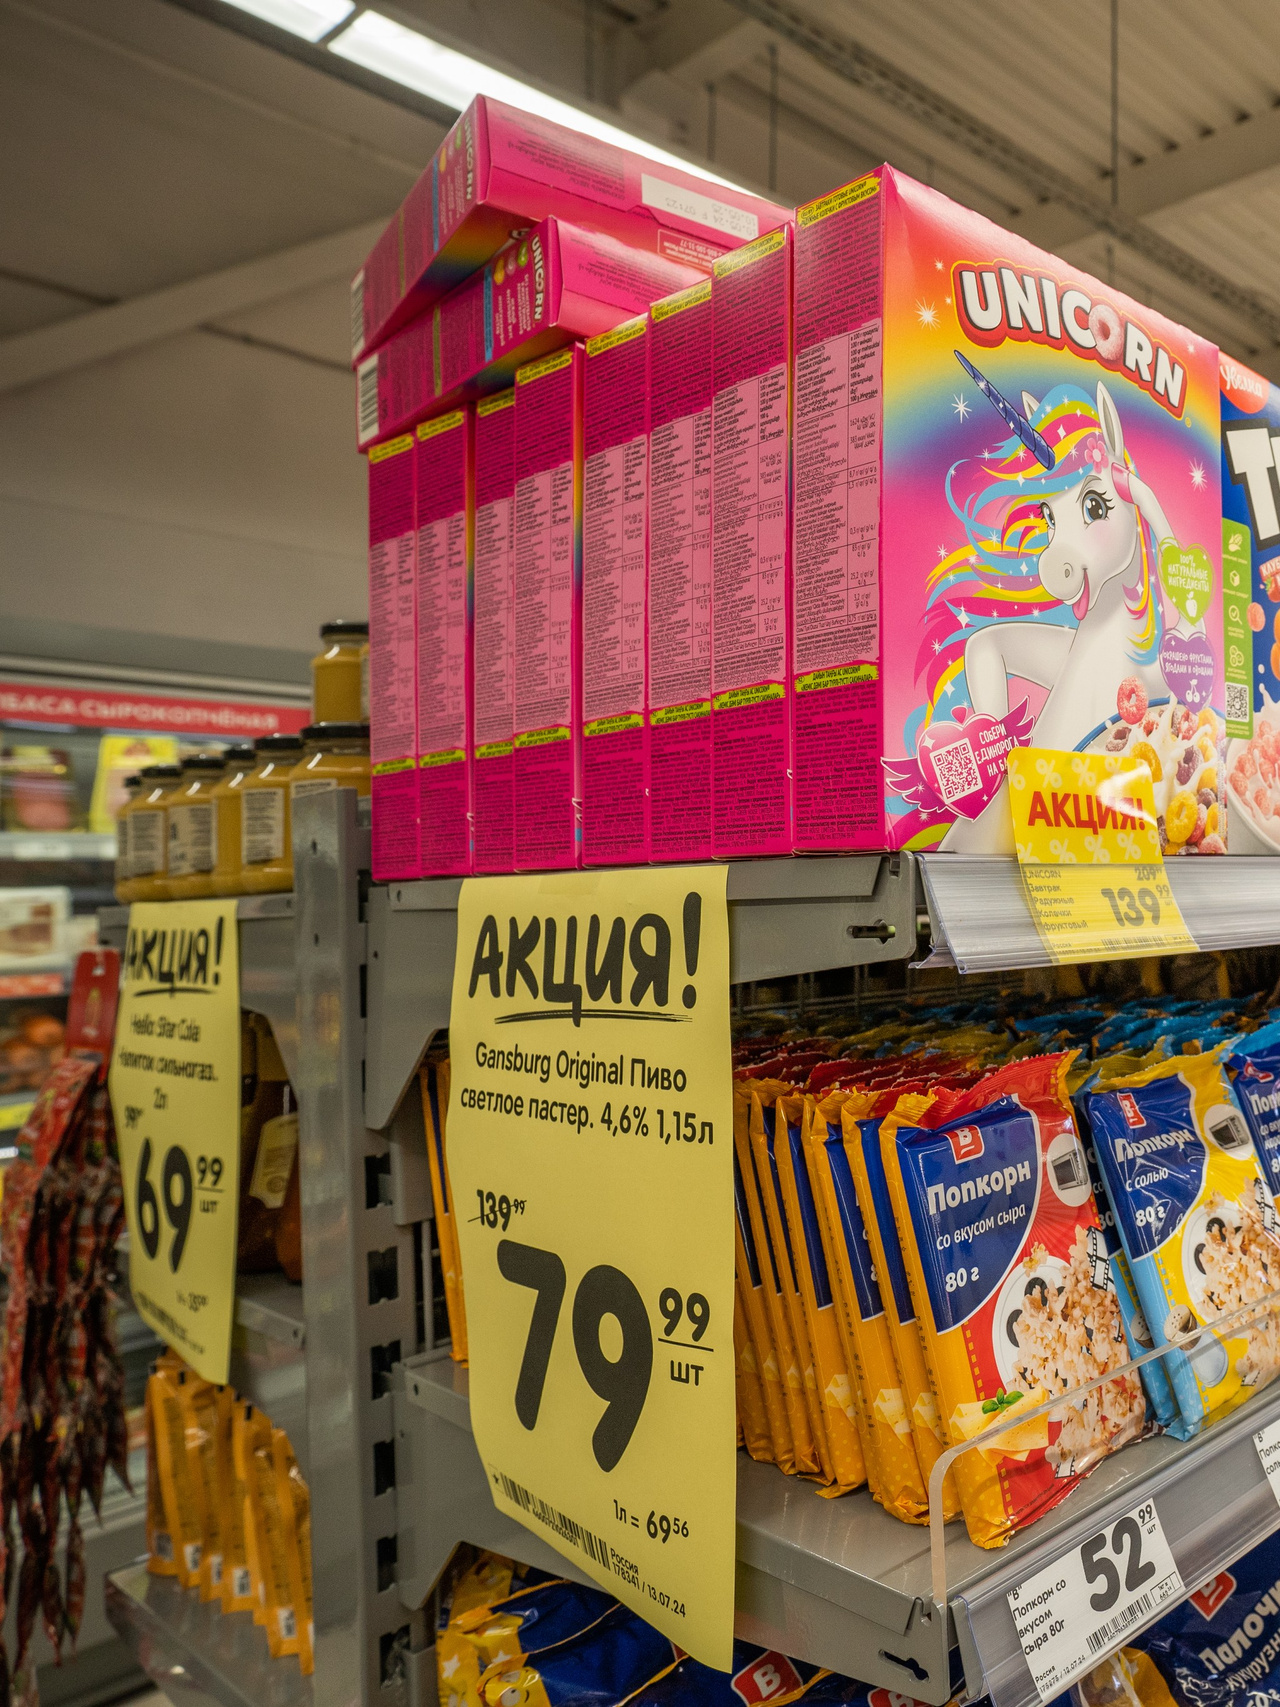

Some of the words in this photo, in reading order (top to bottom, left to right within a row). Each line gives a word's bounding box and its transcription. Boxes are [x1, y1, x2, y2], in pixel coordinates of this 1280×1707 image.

[531, 236, 543, 321] UNICORN
[958, 267, 1186, 410] UNICORN
[1167, 563, 1209, 581] НАТУРАЛЬНЫЕ
[1180, 553, 1196, 567] 100%
[1168, 576, 1210, 592] ИНГРЕДИЕНТЫ
[975, 735, 1020, 764] ЕДИНОРОГА
[987, 762, 999, 777] НА
[1027, 791, 1146, 835] АКЦИЯ!
[1100, 887, 1161, 928] 139
[1156, 884, 1170, 897] 99
[468, 891, 703, 1027] АКЦИЯ!
[475, 1041, 551, 1084] Gansburg
[556, 1050, 625, 1090] Original
[630, 1058, 688, 1093] Пиво
[460, 1086, 524, 1117] светлое
[528, 1097, 594, 1135] пастер.
[600, 1101, 649, 1139] 4,6%
[657, 1109, 714, 1146] 1,15л
[1260, 1123, 1269, 1136] со
[1114, 1126, 1194, 1164] Попкорн
[927, 1160, 1032, 1217] Попкорн
[1125, 1176, 1133, 1192] с
[1134, 1166, 1169, 1189] солью
[136, 1136, 194, 1274] 69
[195, 1156, 224, 1187] 99
[475, 1189, 512, 1233] 139
[513, 1199, 526, 1216] 99
[1135, 1206, 1155, 1227] 80
[936, 1231, 952, 1252] со
[954, 1215, 995, 1246] вкусом
[996, 1204, 1027, 1231] сыра
[945, 1266, 968, 1293] 80
[496, 1238, 654, 1474] 79
[658, 1287, 711, 1343] 99
[670, 1359, 705, 1387] шт
[612, 1499, 627, 1527] 1л
[646, 1510, 671, 1545] 69
[672, 1516, 690, 1539] 56
[1146, 1524, 1157, 1535] шт
[610, 1546, 640, 1576] Россия
[1080, 1516, 1157, 1613] 52
[1138, 1504, 1153, 1524] 99
[611, 1562, 641, 1592] 178341
[646, 1583, 687, 1619] 13.07.24
[1012, 1587, 1055, 1622] Попкорн
[1055, 1579, 1067, 1590] со
[1018, 1608, 1053, 1639] вкусом
[1023, 1635, 1049, 1656] сыра
[1049, 1618, 1066, 1637] 80г
[752, 1662, 782, 1699] В
[1035, 1664, 1057, 1684] Россия
